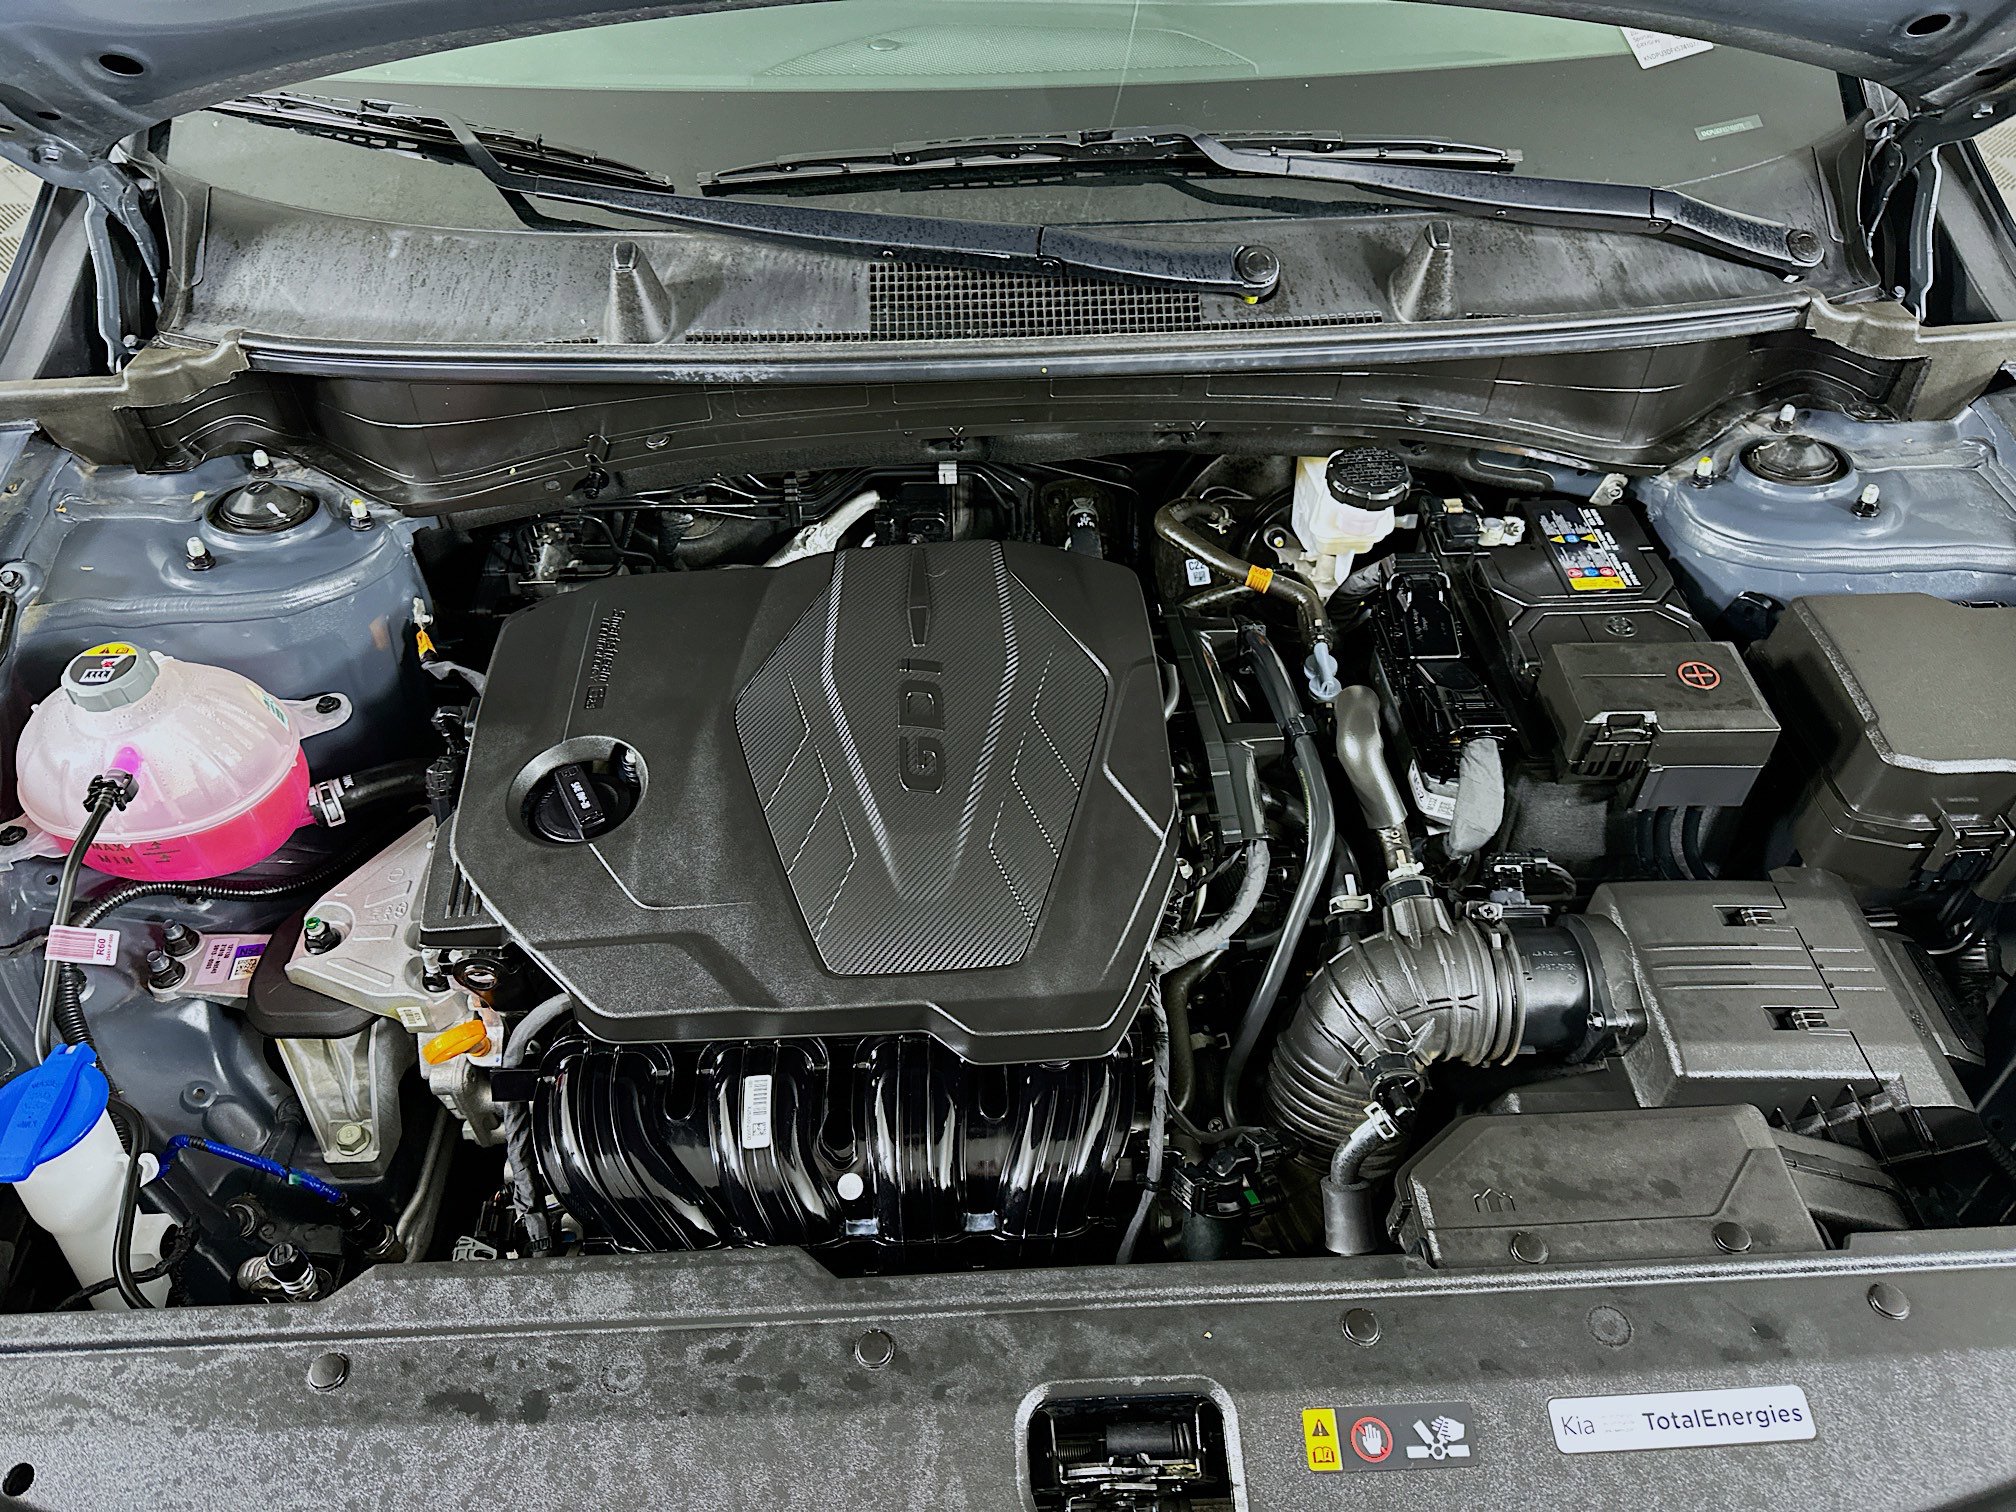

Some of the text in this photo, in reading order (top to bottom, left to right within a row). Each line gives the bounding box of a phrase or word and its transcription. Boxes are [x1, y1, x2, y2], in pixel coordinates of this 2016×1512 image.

[599, 608, 626, 683] Smartstream
[91, 843, 125, 852] MAX
[97, 854, 133, 864] MIN
[96, 938, 106, 956] R60
[1561, 1415, 1596, 1437] Kia
[1642, 1404, 1804, 1431] TotalEnergies
